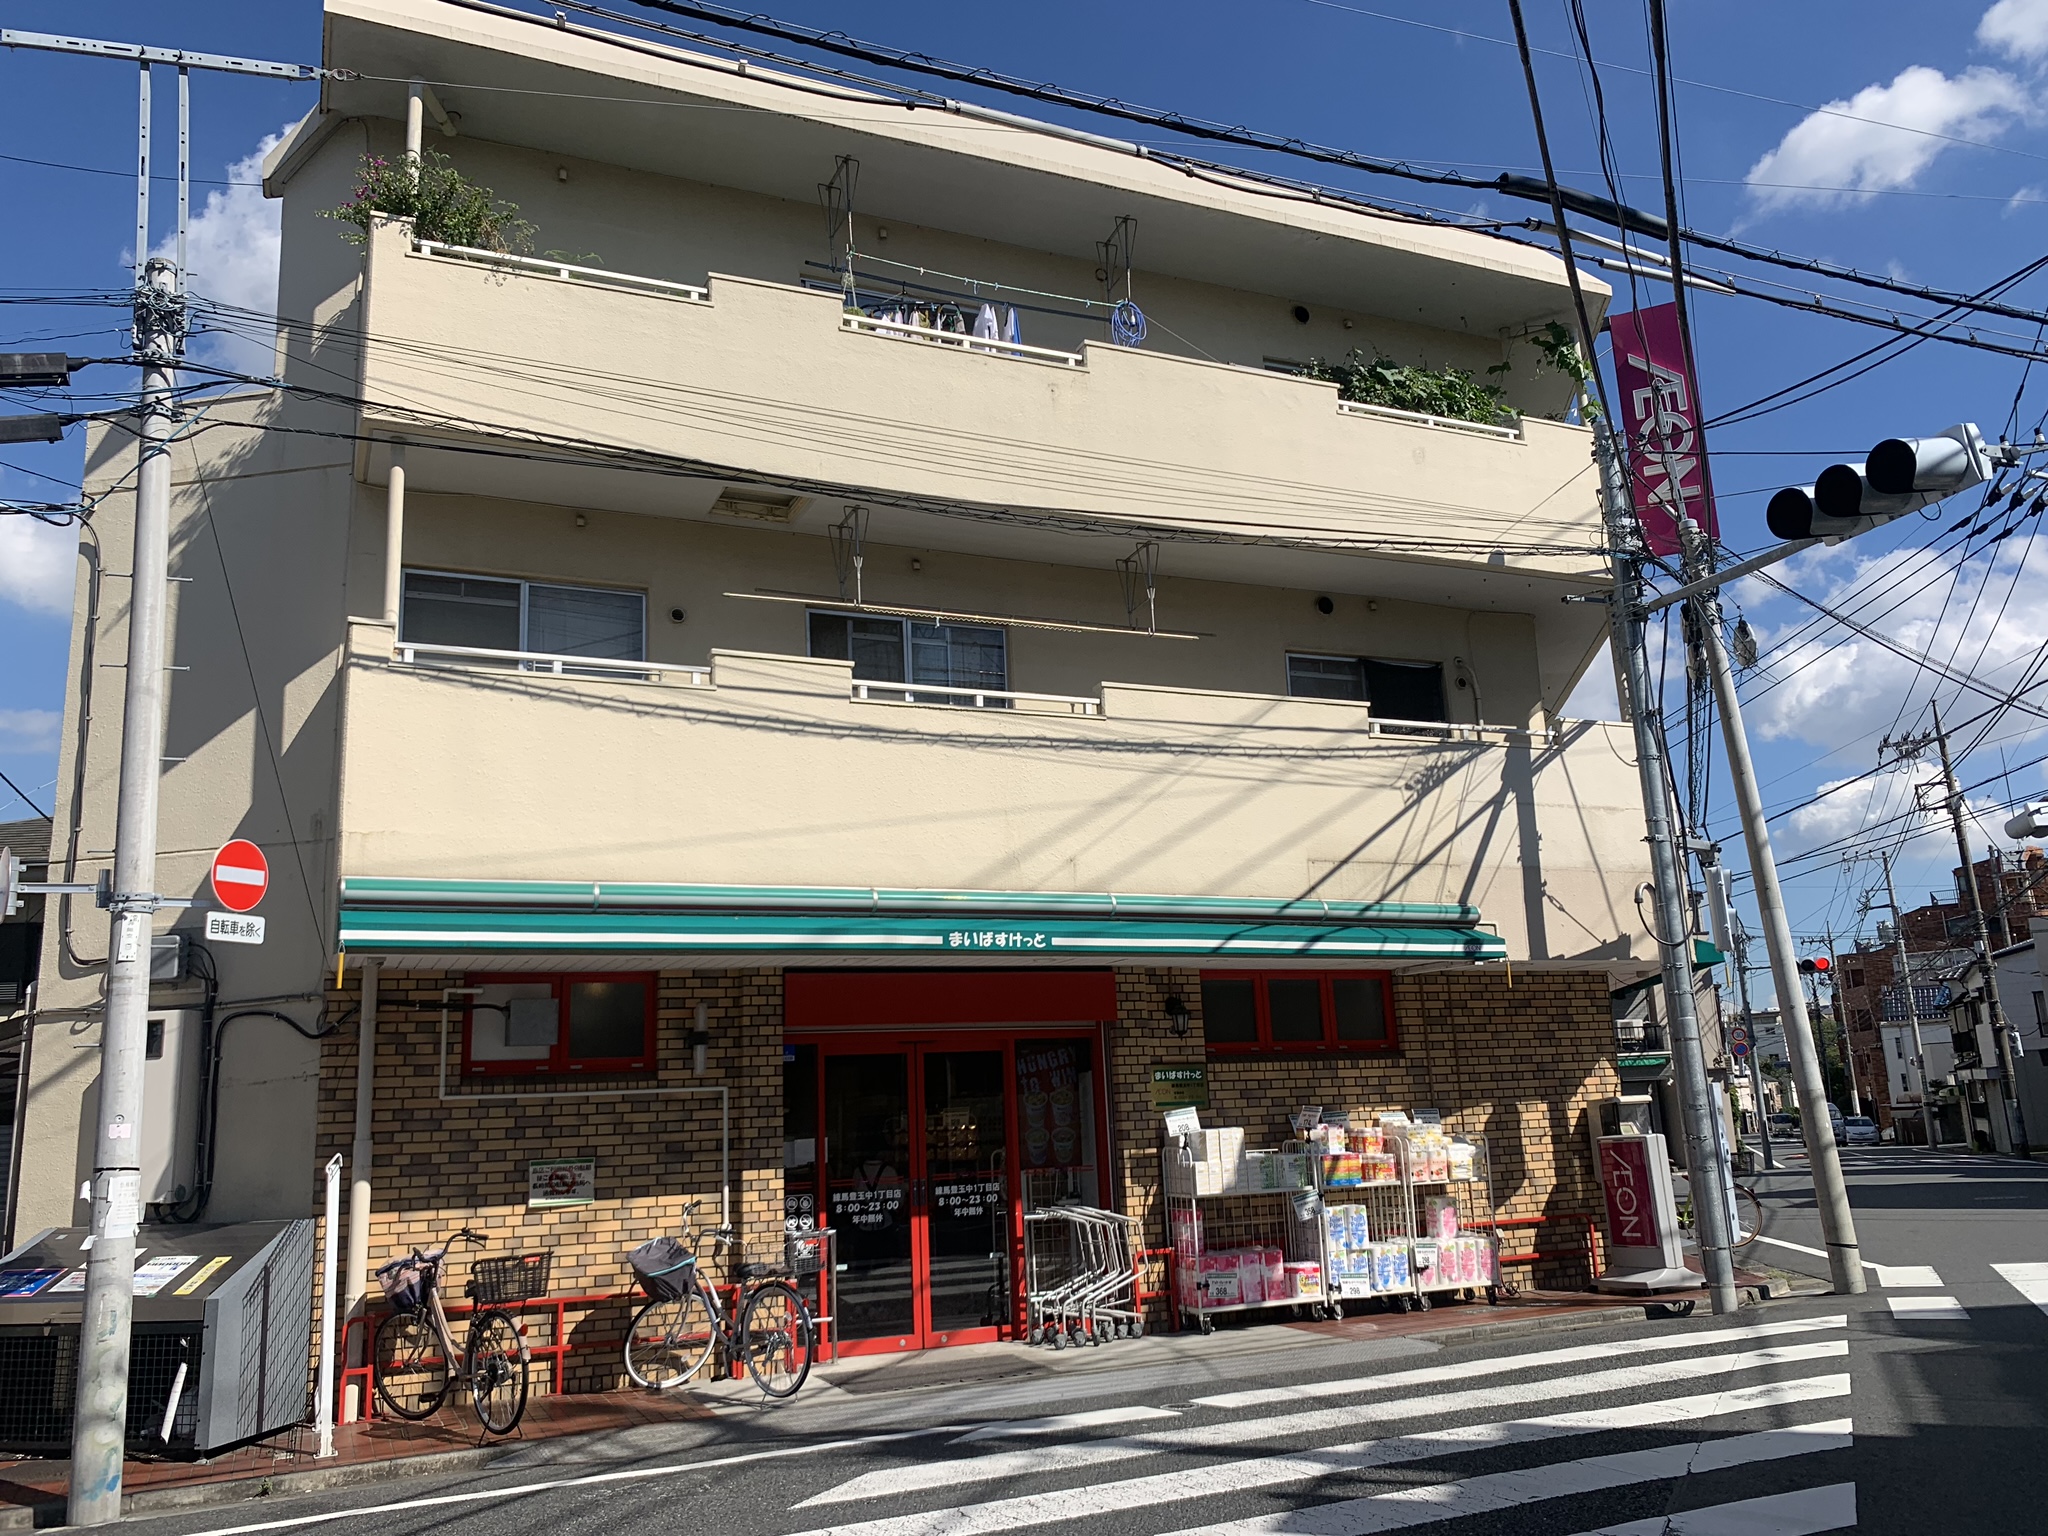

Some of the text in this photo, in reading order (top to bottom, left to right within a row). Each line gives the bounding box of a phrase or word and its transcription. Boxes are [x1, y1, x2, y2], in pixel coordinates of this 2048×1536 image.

[210, 919, 262, 938] 自転車を除く
[949, 931, 1046, 948] まいばすけっと
[1017, 1046, 1077, 1076] HUNGRY
[1154, 1070, 1202, 1081] まいばすけっと
[1215, 1286, 1228, 1296] 368
